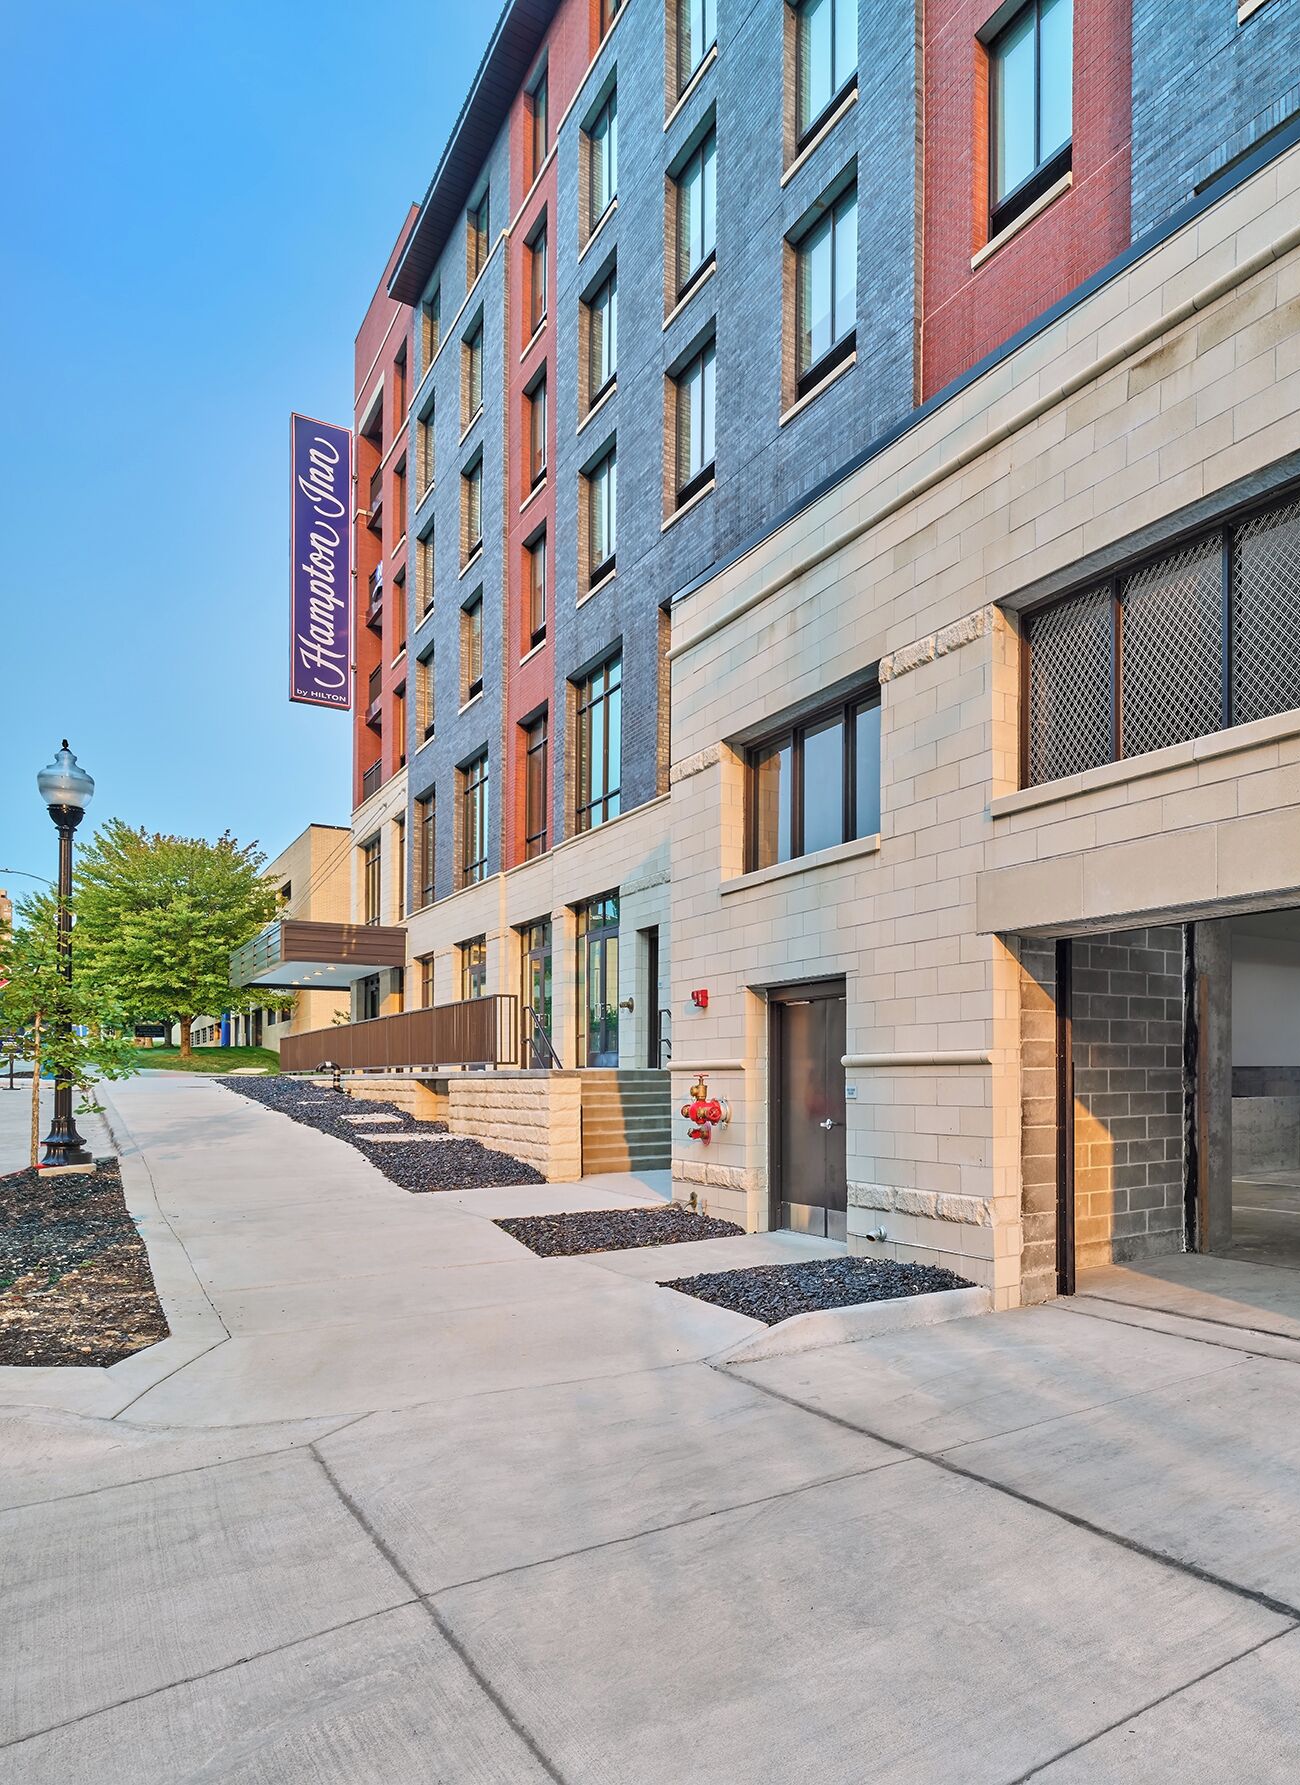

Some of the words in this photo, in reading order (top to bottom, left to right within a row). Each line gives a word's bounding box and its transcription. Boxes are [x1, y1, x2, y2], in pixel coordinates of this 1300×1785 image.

[299, 437, 346, 518] Inn
[297, 520, 346, 689] Hampton
[296, 688, 308, 696] by
[310, 690, 347, 702] HILTON
